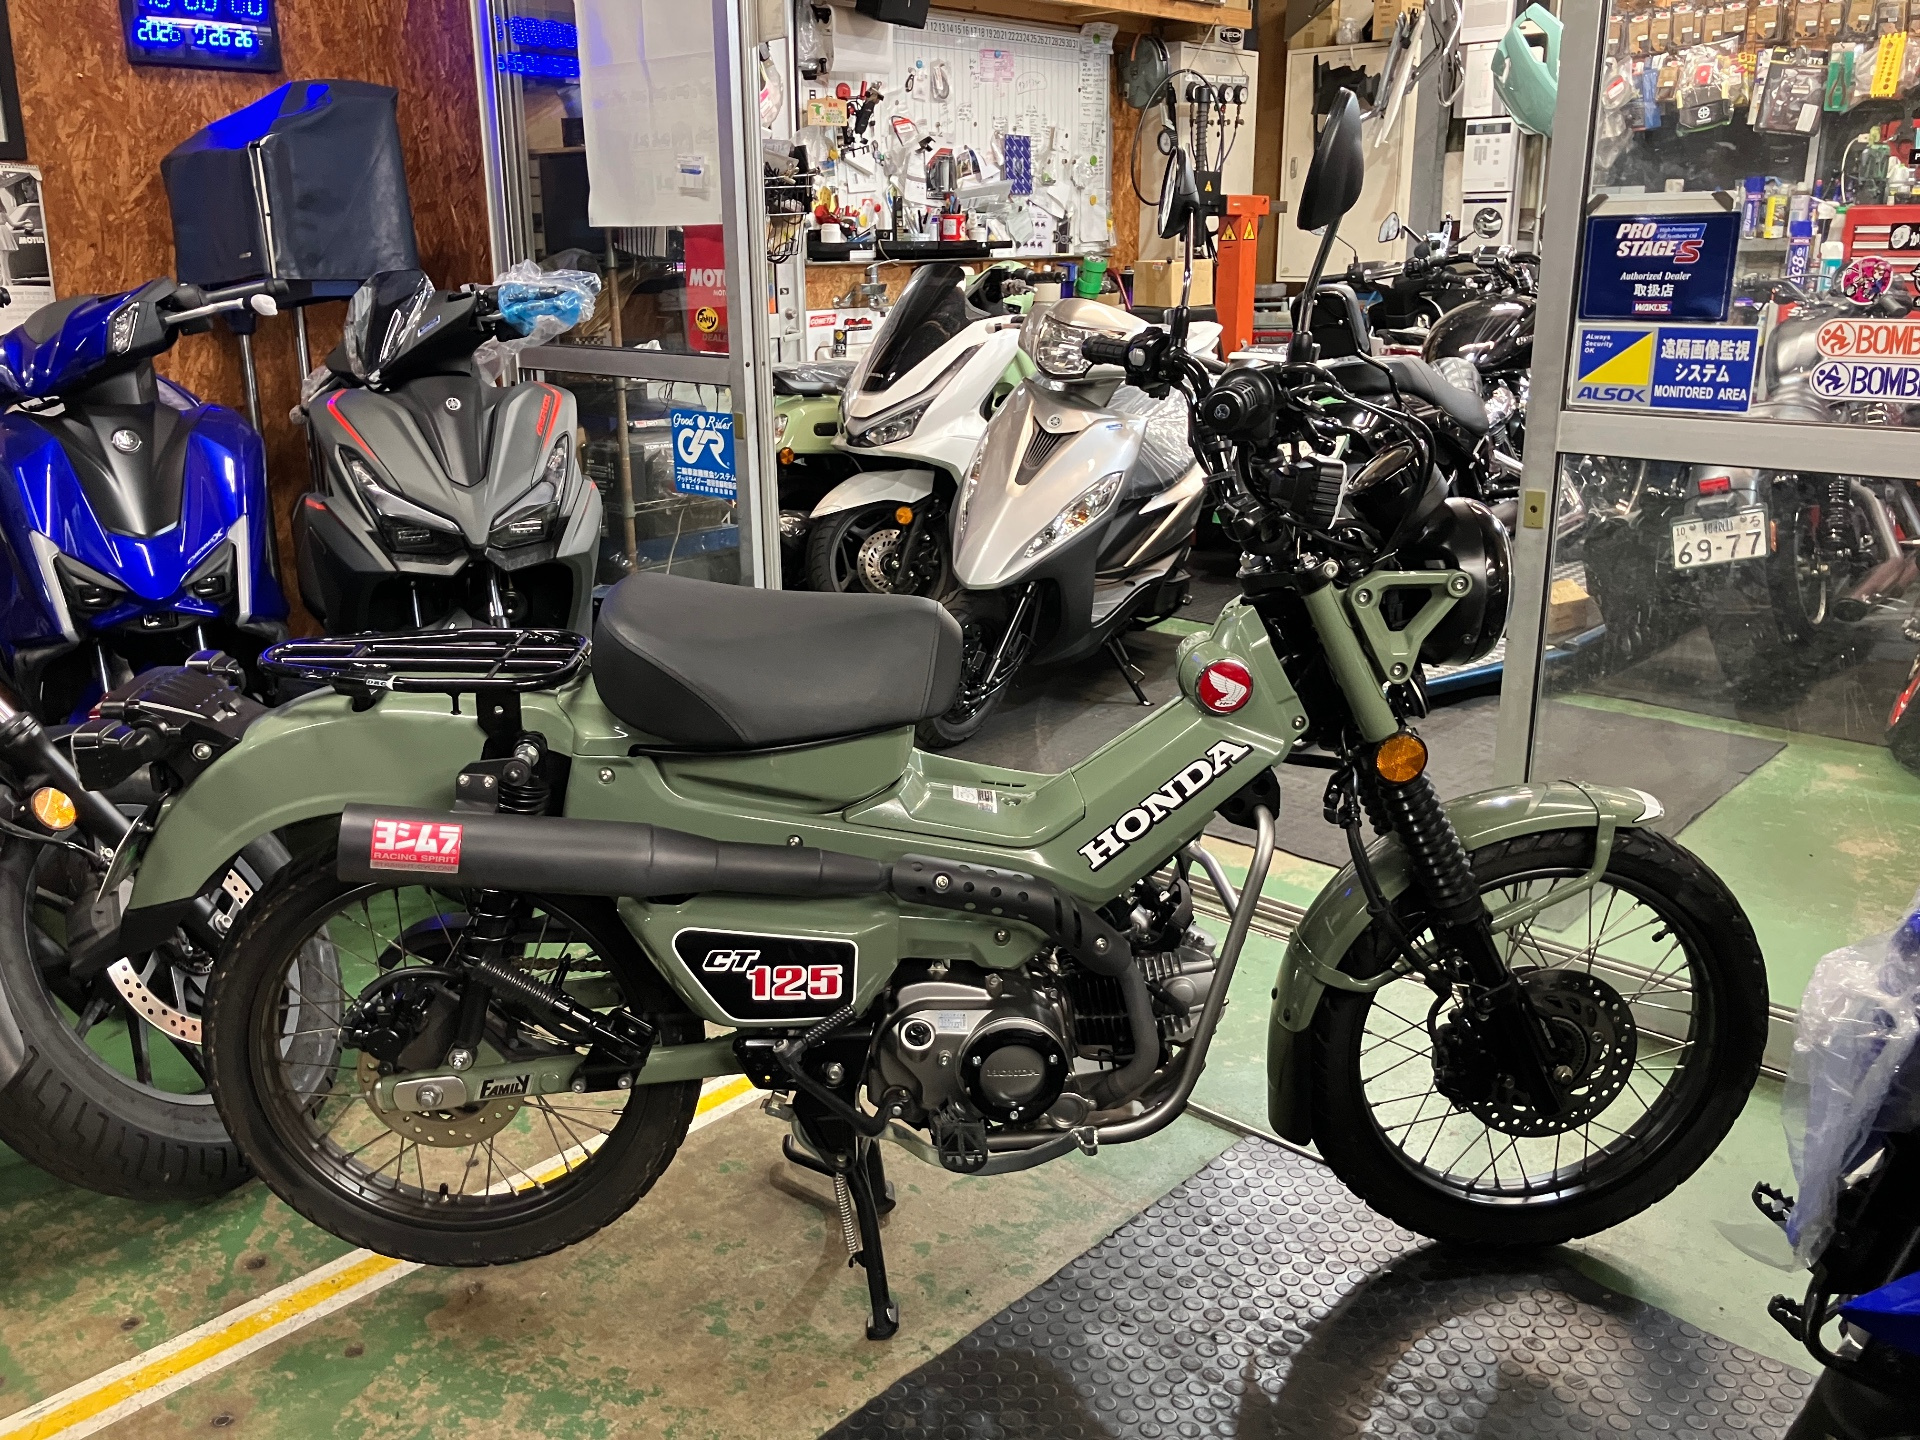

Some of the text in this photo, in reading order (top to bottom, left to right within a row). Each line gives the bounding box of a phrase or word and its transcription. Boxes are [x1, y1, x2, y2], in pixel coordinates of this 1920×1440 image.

[930, 22, 937, 31] 12
[938, 22, 945, 32] 13
[946, 24, 953, 33] 14
[954, 25, 961, 34] 15
[962, 26, 969, 35] 16
[978, 28, 985, 37] 18
[986, 29, 992, 38] 19
[993, 29, 1000, 39] 20
[1001, 30, 1007, 39] 21
[1008, 31, 1015, 41] 22
[1015, 32, 1022, 42] 23
[1023, 33, 1030, 42] 24
[1030, 34, 1037, 43] 25
[1037, 35, 1044, 44] 26
[1044, 36, 1051, 45] 27
[1051, 37, 1058, 46] 28
[1058, 38, 1065, 47] 29
[1065, 38, 1072, 48] 30
[1072, 39, 1079, 48] 31
[18, 236, 45, 245] MOTUL
[1615, 222, 1657, 240] PRO
[1616, 239, 1705, 264] STAGE S
[1620, 271, 1691, 281] Authorized Dealer
[1633, 283, 1675, 297] 取扱店
[1584, 340, 1613, 348] Security
[1660, 338, 1751, 361] 遠隔画像監視
[1675, 363, 1730, 383] システム
[1577, 386, 1646, 402] ALSOK
[1653, 385, 1747, 401] MONITORED AREA
[673, 412, 733, 432] Good Rider
[1678, 530, 1762, 564] 69-77
[1077, 740, 1254, 872] HONDA
[374, 820, 460, 854] ヨシムラ
[373, 851, 457, 863] RACING SPIRIT
[702, 950, 761, 972] CT
[746, 964, 843, 1000] 125
